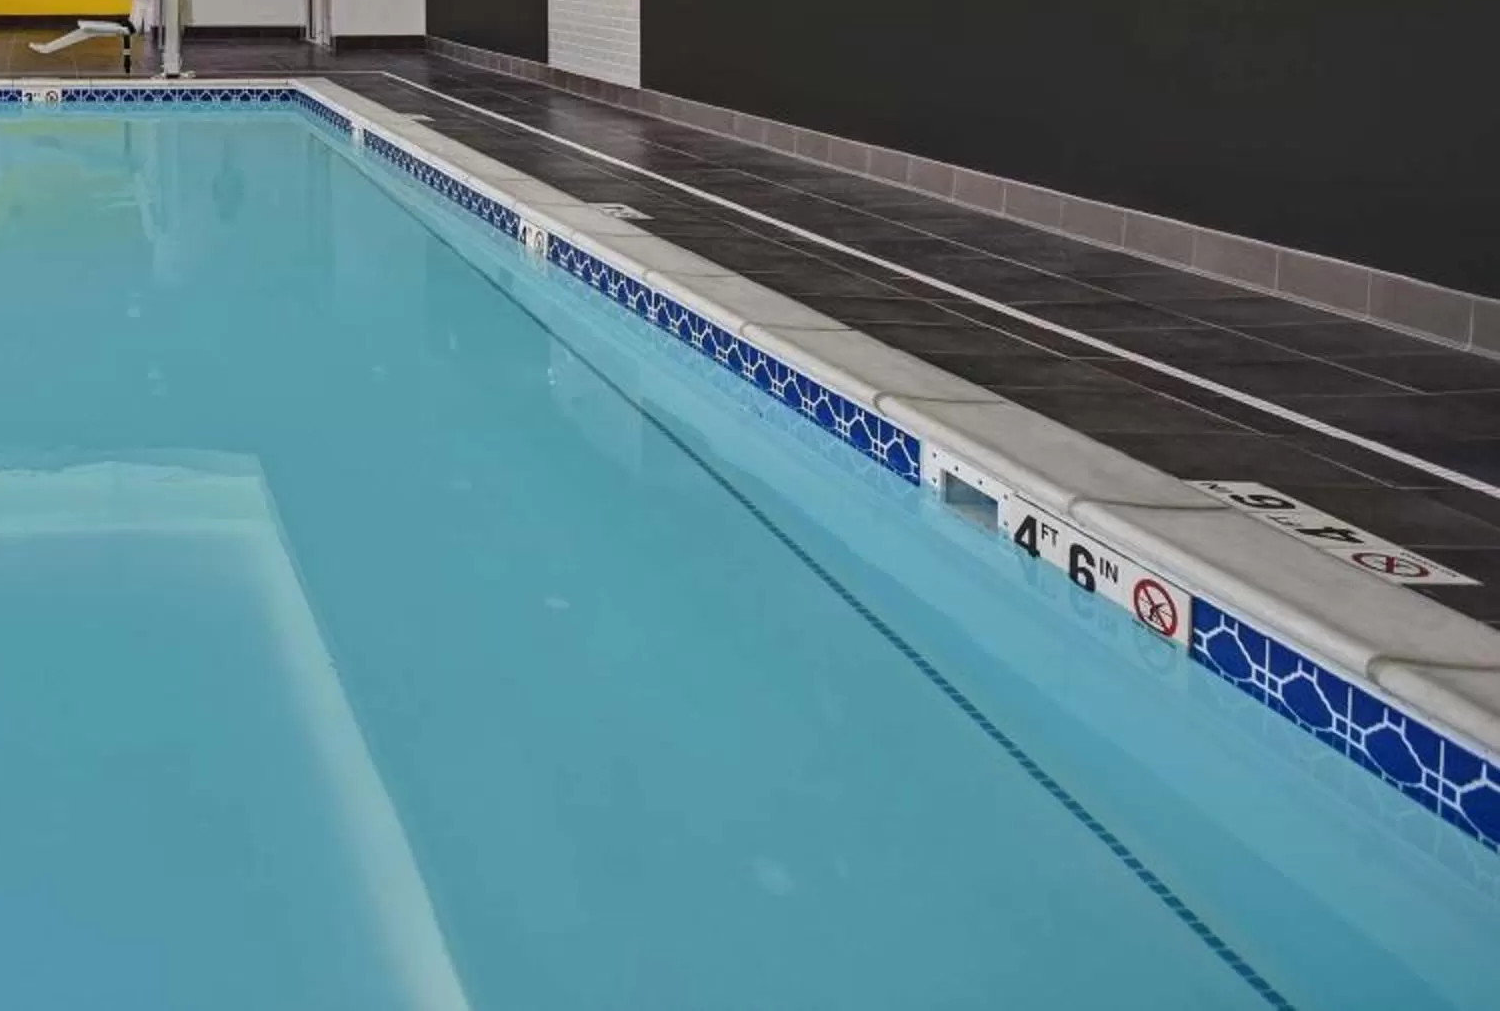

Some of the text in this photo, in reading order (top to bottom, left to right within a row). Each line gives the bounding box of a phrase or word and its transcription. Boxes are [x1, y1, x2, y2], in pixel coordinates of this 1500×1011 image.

[1014, 514, 1119, 594] 4 FT 6 IN
[1296, 527, 1365, 544] 4
